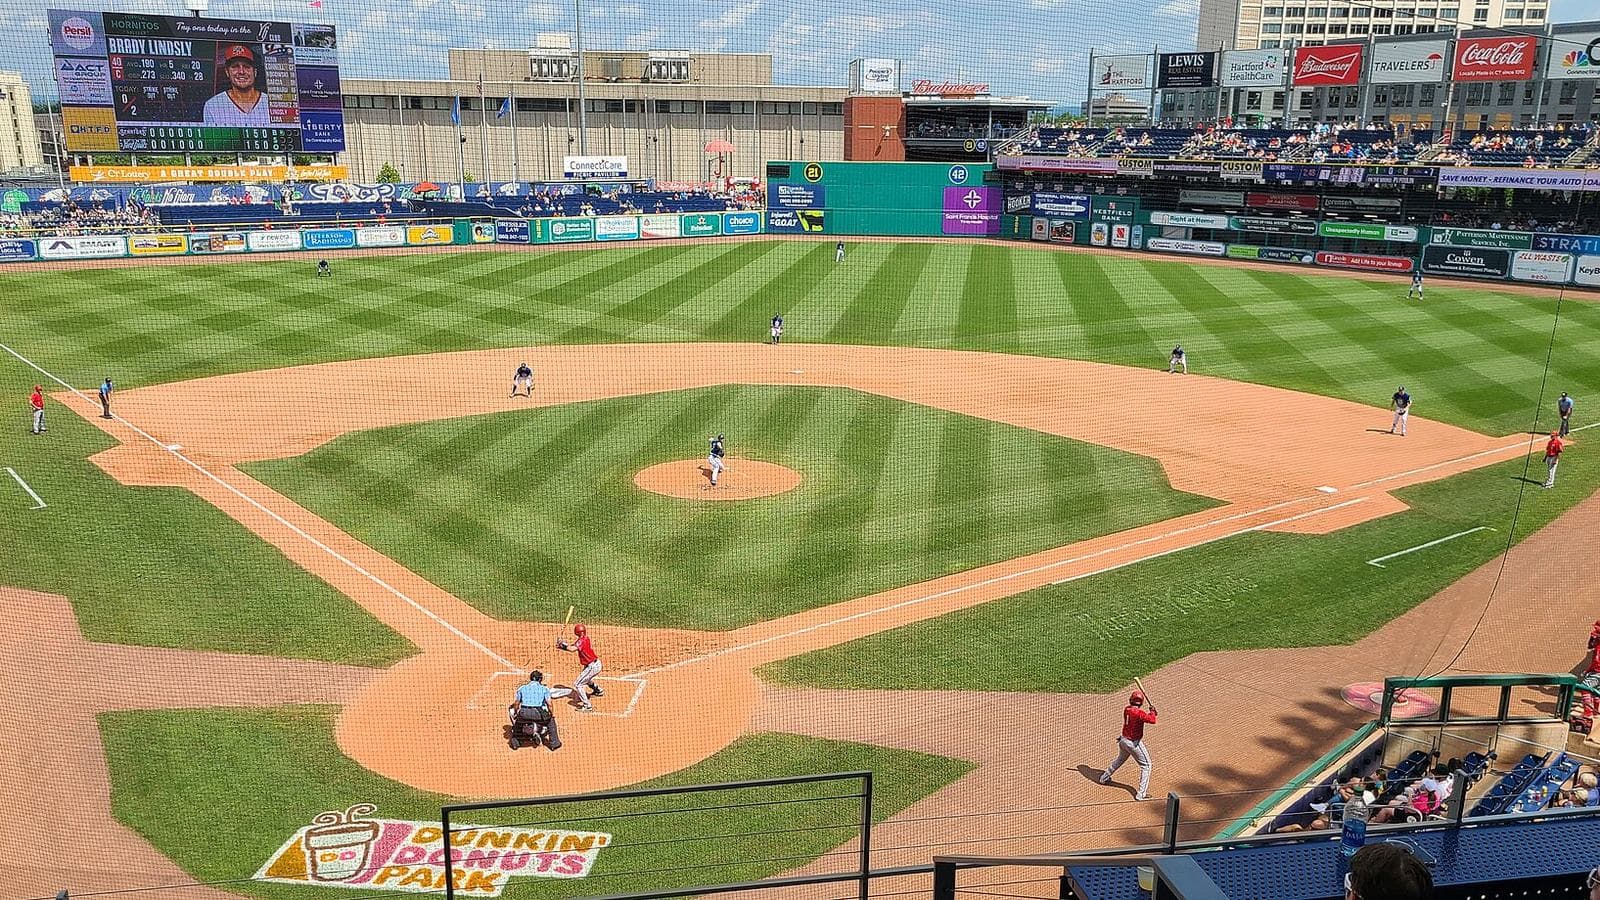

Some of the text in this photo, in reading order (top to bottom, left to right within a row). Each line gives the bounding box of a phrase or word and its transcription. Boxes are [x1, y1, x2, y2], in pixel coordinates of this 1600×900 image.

[64, 26, 91, 36] Persil
[111, 20, 160, 31] HORNITOS
[176, 22, 191, 33] Try
[207, 24, 229, 36] today
[230, 25, 239, 33] in
[239, 26, 252, 34] the
[109, 37, 193, 57] BRADY LINDSLY
[1461, 41, 1529, 66] Coca-Cola
[112, 57, 122, 66] 40
[168, 60, 174, 69] 5
[191, 61, 201, 70] 20
[1168, 54, 1204, 67] LEWIS
[1374, 59, 1430, 73] TRAVELERS
[75, 63, 104, 72] ACT
[1230, 62, 1264, 72] Hartford
[1301, 60, 1352, 74] Budweiser
[116, 70, 121, 79] C
[140, 70, 156, 80] .273
[171, 71, 186, 81] .340
[1229, 71, 1274, 81] HealthCare
[912, 80, 990, 94] Budweiser
[121, 93, 128, 104] 0
[130, 105, 137, 116] 2
[149, 128, 156, 138] 0
[159, 128, 165, 138] 0
[168, 128, 174, 138] 0
[177, 128, 184, 138] 0
[187, 128, 193, 138] 0
[262, 129, 268, 138] 0
[151, 140, 157, 150] 0
[160, 140, 166, 150] 0
[179, 140, 185, 150] 0
[188, 140, 195, 150] 0
[197, 140, 204, 150] 0
[263, 140, 269, 150] 0
[569, 160, 623, 170] ConnectiCare
[1117, 158, 1152, 169] CUSTOM
[1223, 162, 1262, 172] CUSTOM
[807, 167, 819, 178] 21
[951, 169, 965, 180] 42
[1460, 175, 1488, 183] MONEY
[1493, 176, 1535, 185] REFINANCE
[1536, 176, 1557, 185] YOUR
[1558, 178, 1582, 186] AUTO
[1007, 196, 1031, 209] HOOKER
[977, 213, 998, 221] Hospital
[1093, 208, 1133, 216] WESTFIELD
[729, 215, 754, 225] choice
[1169, 214, 1186, 225] Right
[1196, 217, 1215, 225] Home
[1325, 226, 1360, 235] Unexpectedly
[1456, 231, 1529, 241] PATTERSON MAINTENANCE
[311, 237, 352, 245] RADIOLOGY
[1446, 253, 1484, 264] Cowen
[1519, 252, 1562, 262] ALL WASTE
[1376, 260, 1387, 268] your
[411, 825, 606, 853] DUNKIN'
[391, 844, 587, 876] DONUTS
[373, 864, 501, 894] PARK
